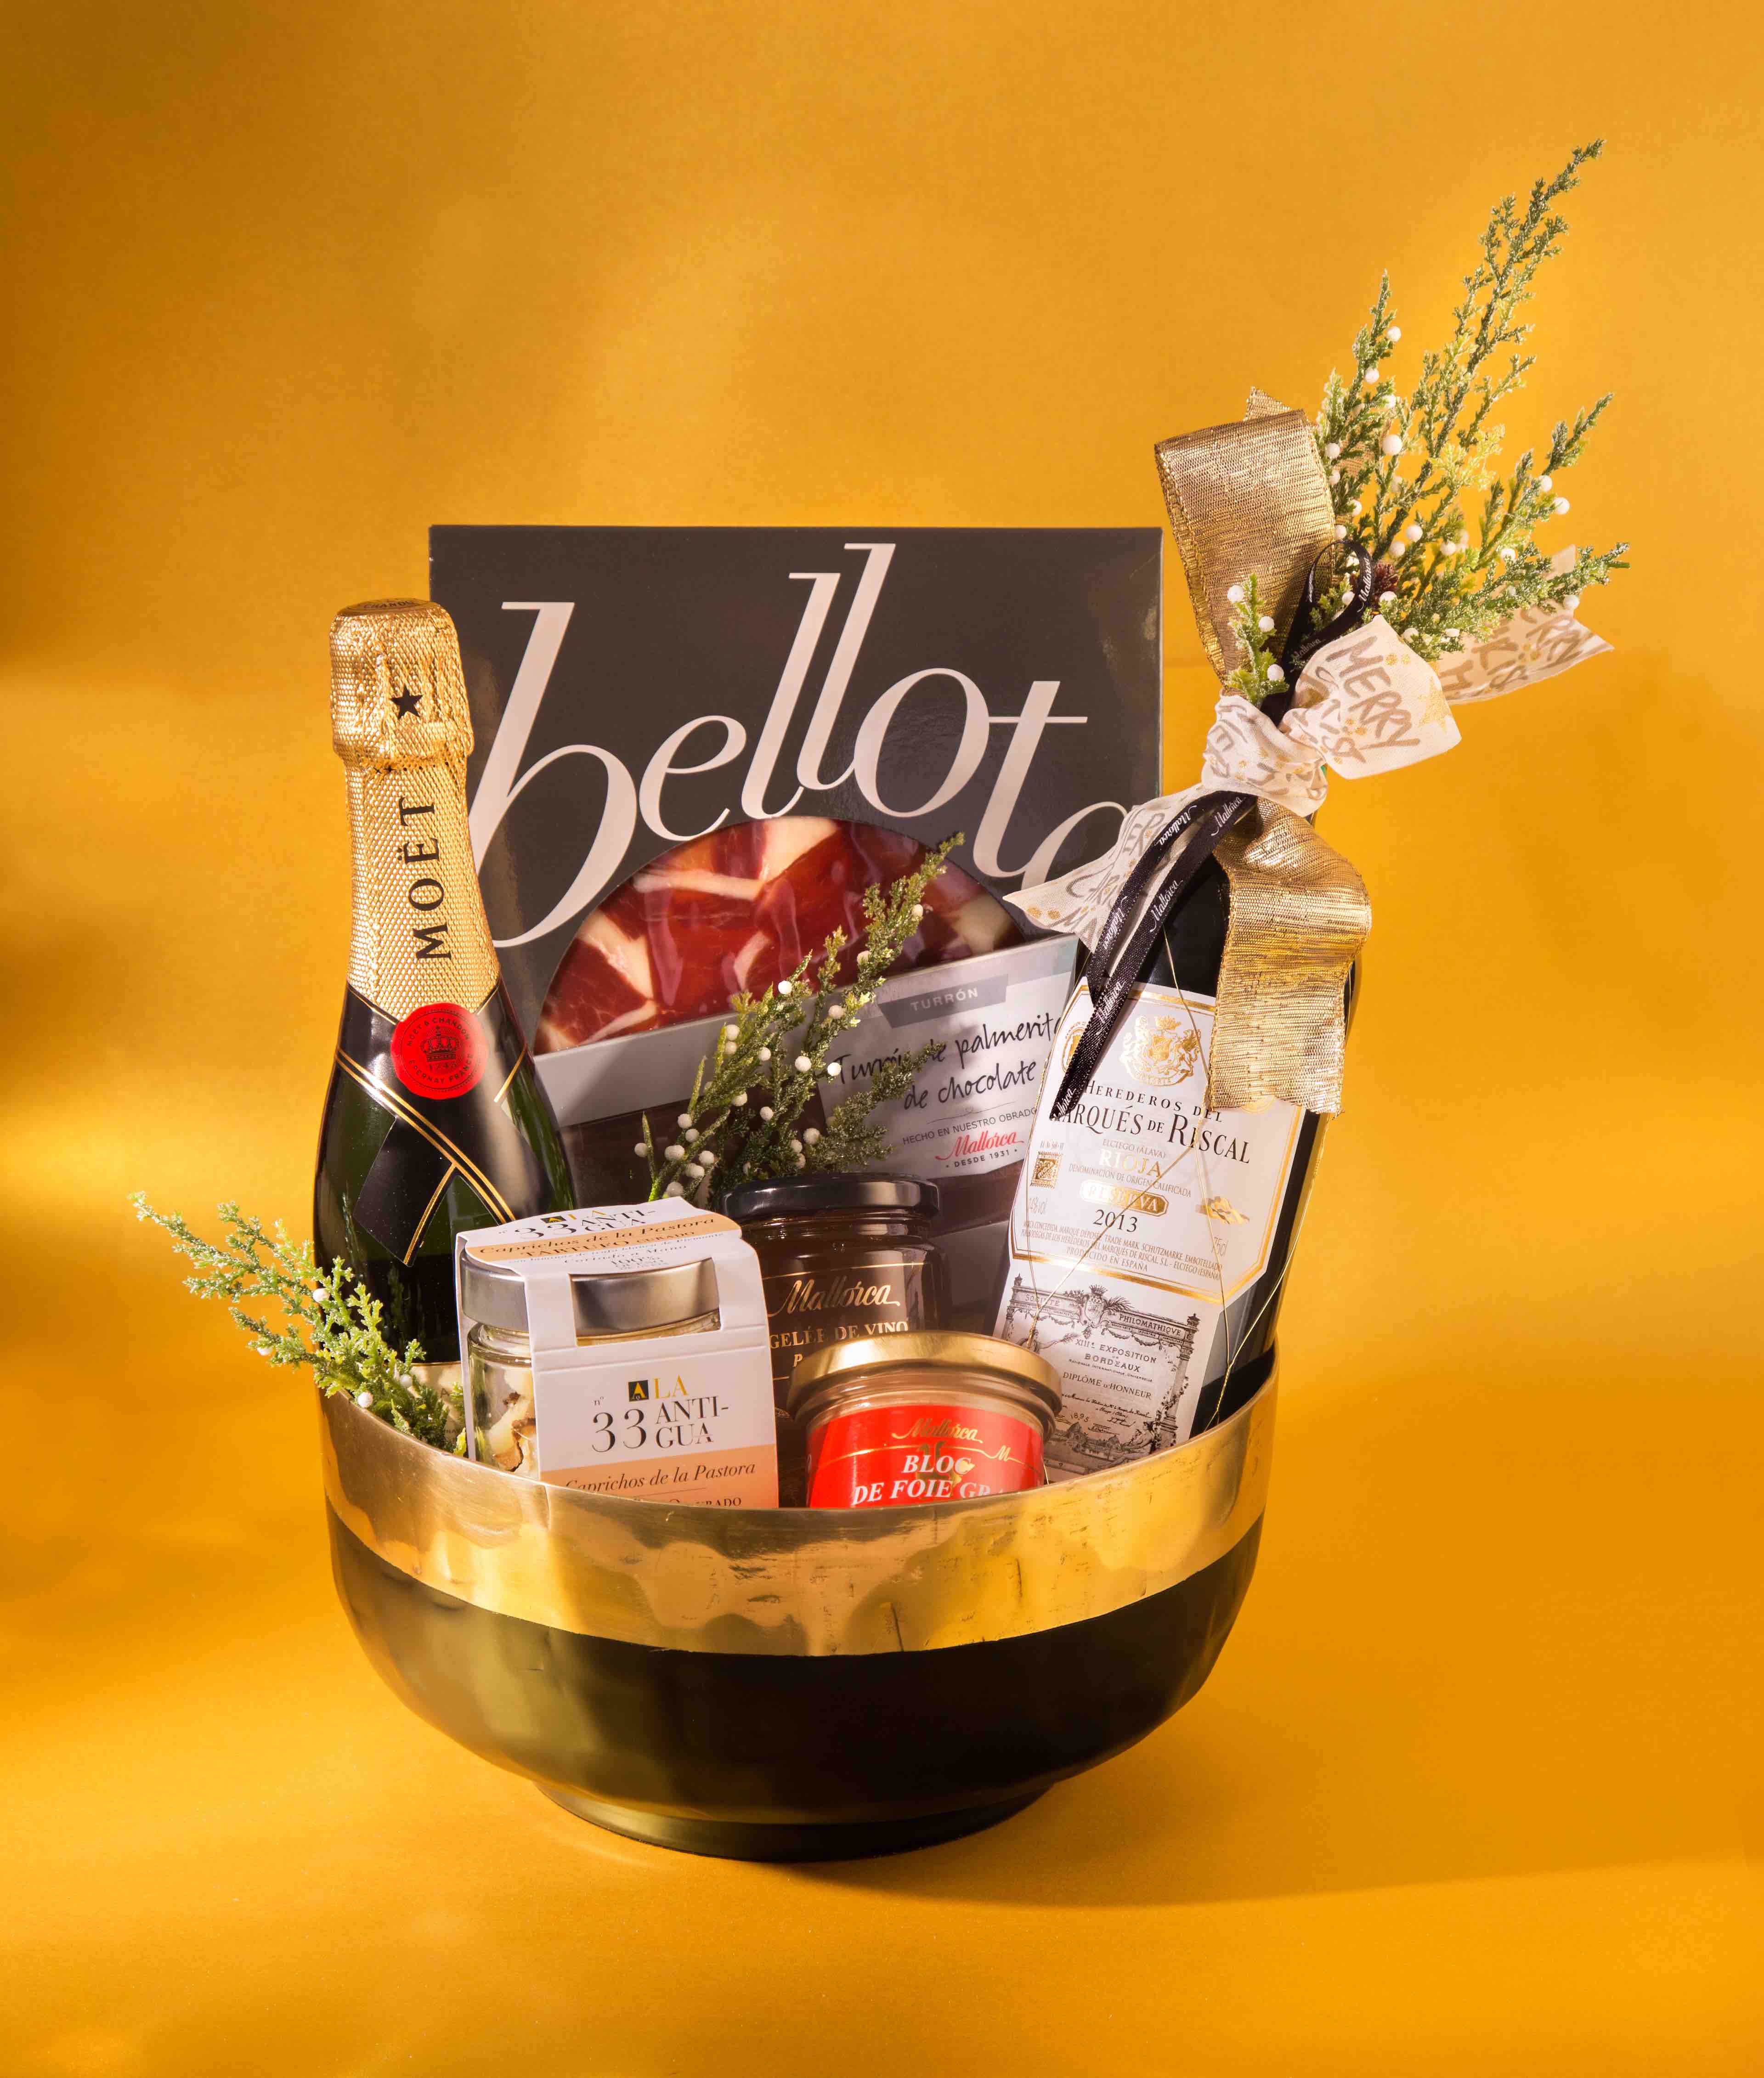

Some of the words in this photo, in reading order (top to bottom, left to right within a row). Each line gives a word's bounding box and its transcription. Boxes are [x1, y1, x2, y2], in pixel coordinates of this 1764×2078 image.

[1326, 636, 1420, 750] MERRY
[398, 797, 452, 960] MOËT
[910, 987, 978, 1011] TURRÓN
[904, 1084, 927, 1110] de
[938, 1060, 1036, 1103] chocolate
[1084, 1080, 1182, 1112] HEREDEROS
[1193, 1106, 1222, 1123] DEL
[903, 1130, 935, 1145] HECHO
[938, 1128, 950, 1137] EN
[953, 1117, 996, 1134] NUESTRO
[999, 1107, 1037, 1123] OBRADO
[1057, 1104, 1143, 1135] ARQUÉS
[1148, 1119, 1165, 1134] DE
[1167, 1113, 1250, 1163] RISCAL
[954, 1154, 986, 1168] DESDE
[989, 1149, 1010, 1160] 1931
[1099, 1149, 1162, 1178] RIOJA
[1092, 1209, 1138, 1232] 2013
[1105, 1234, 1122, 1244] TRADE
[1109, 1255, 1119, 1265] EN
[835, 1325, 860, 1340] DE
[864, 1321, 910, 1336] VINO
[1085, 1353, 1141, 1373] BORDEAUX
[1099, 1344, 1157, 1364] EXPOSITION
[654, 1374, 689, 1400] LA
[1063, 1372, 1103, 1387] DIPLÔME
[656, 1423, 714, 1449] GUA
[650, 1468, 668, 1486] de
[673, 1467, 688, 1483] la
[694, 1462, 756, 1481] Pastora
[902, 1455, 972, 1475] BLOC
[851, 1482, 885, 1506] DE
[889, 1479, 954, 1499] FOIE
[959, 1481, 1005, 1499] GR
